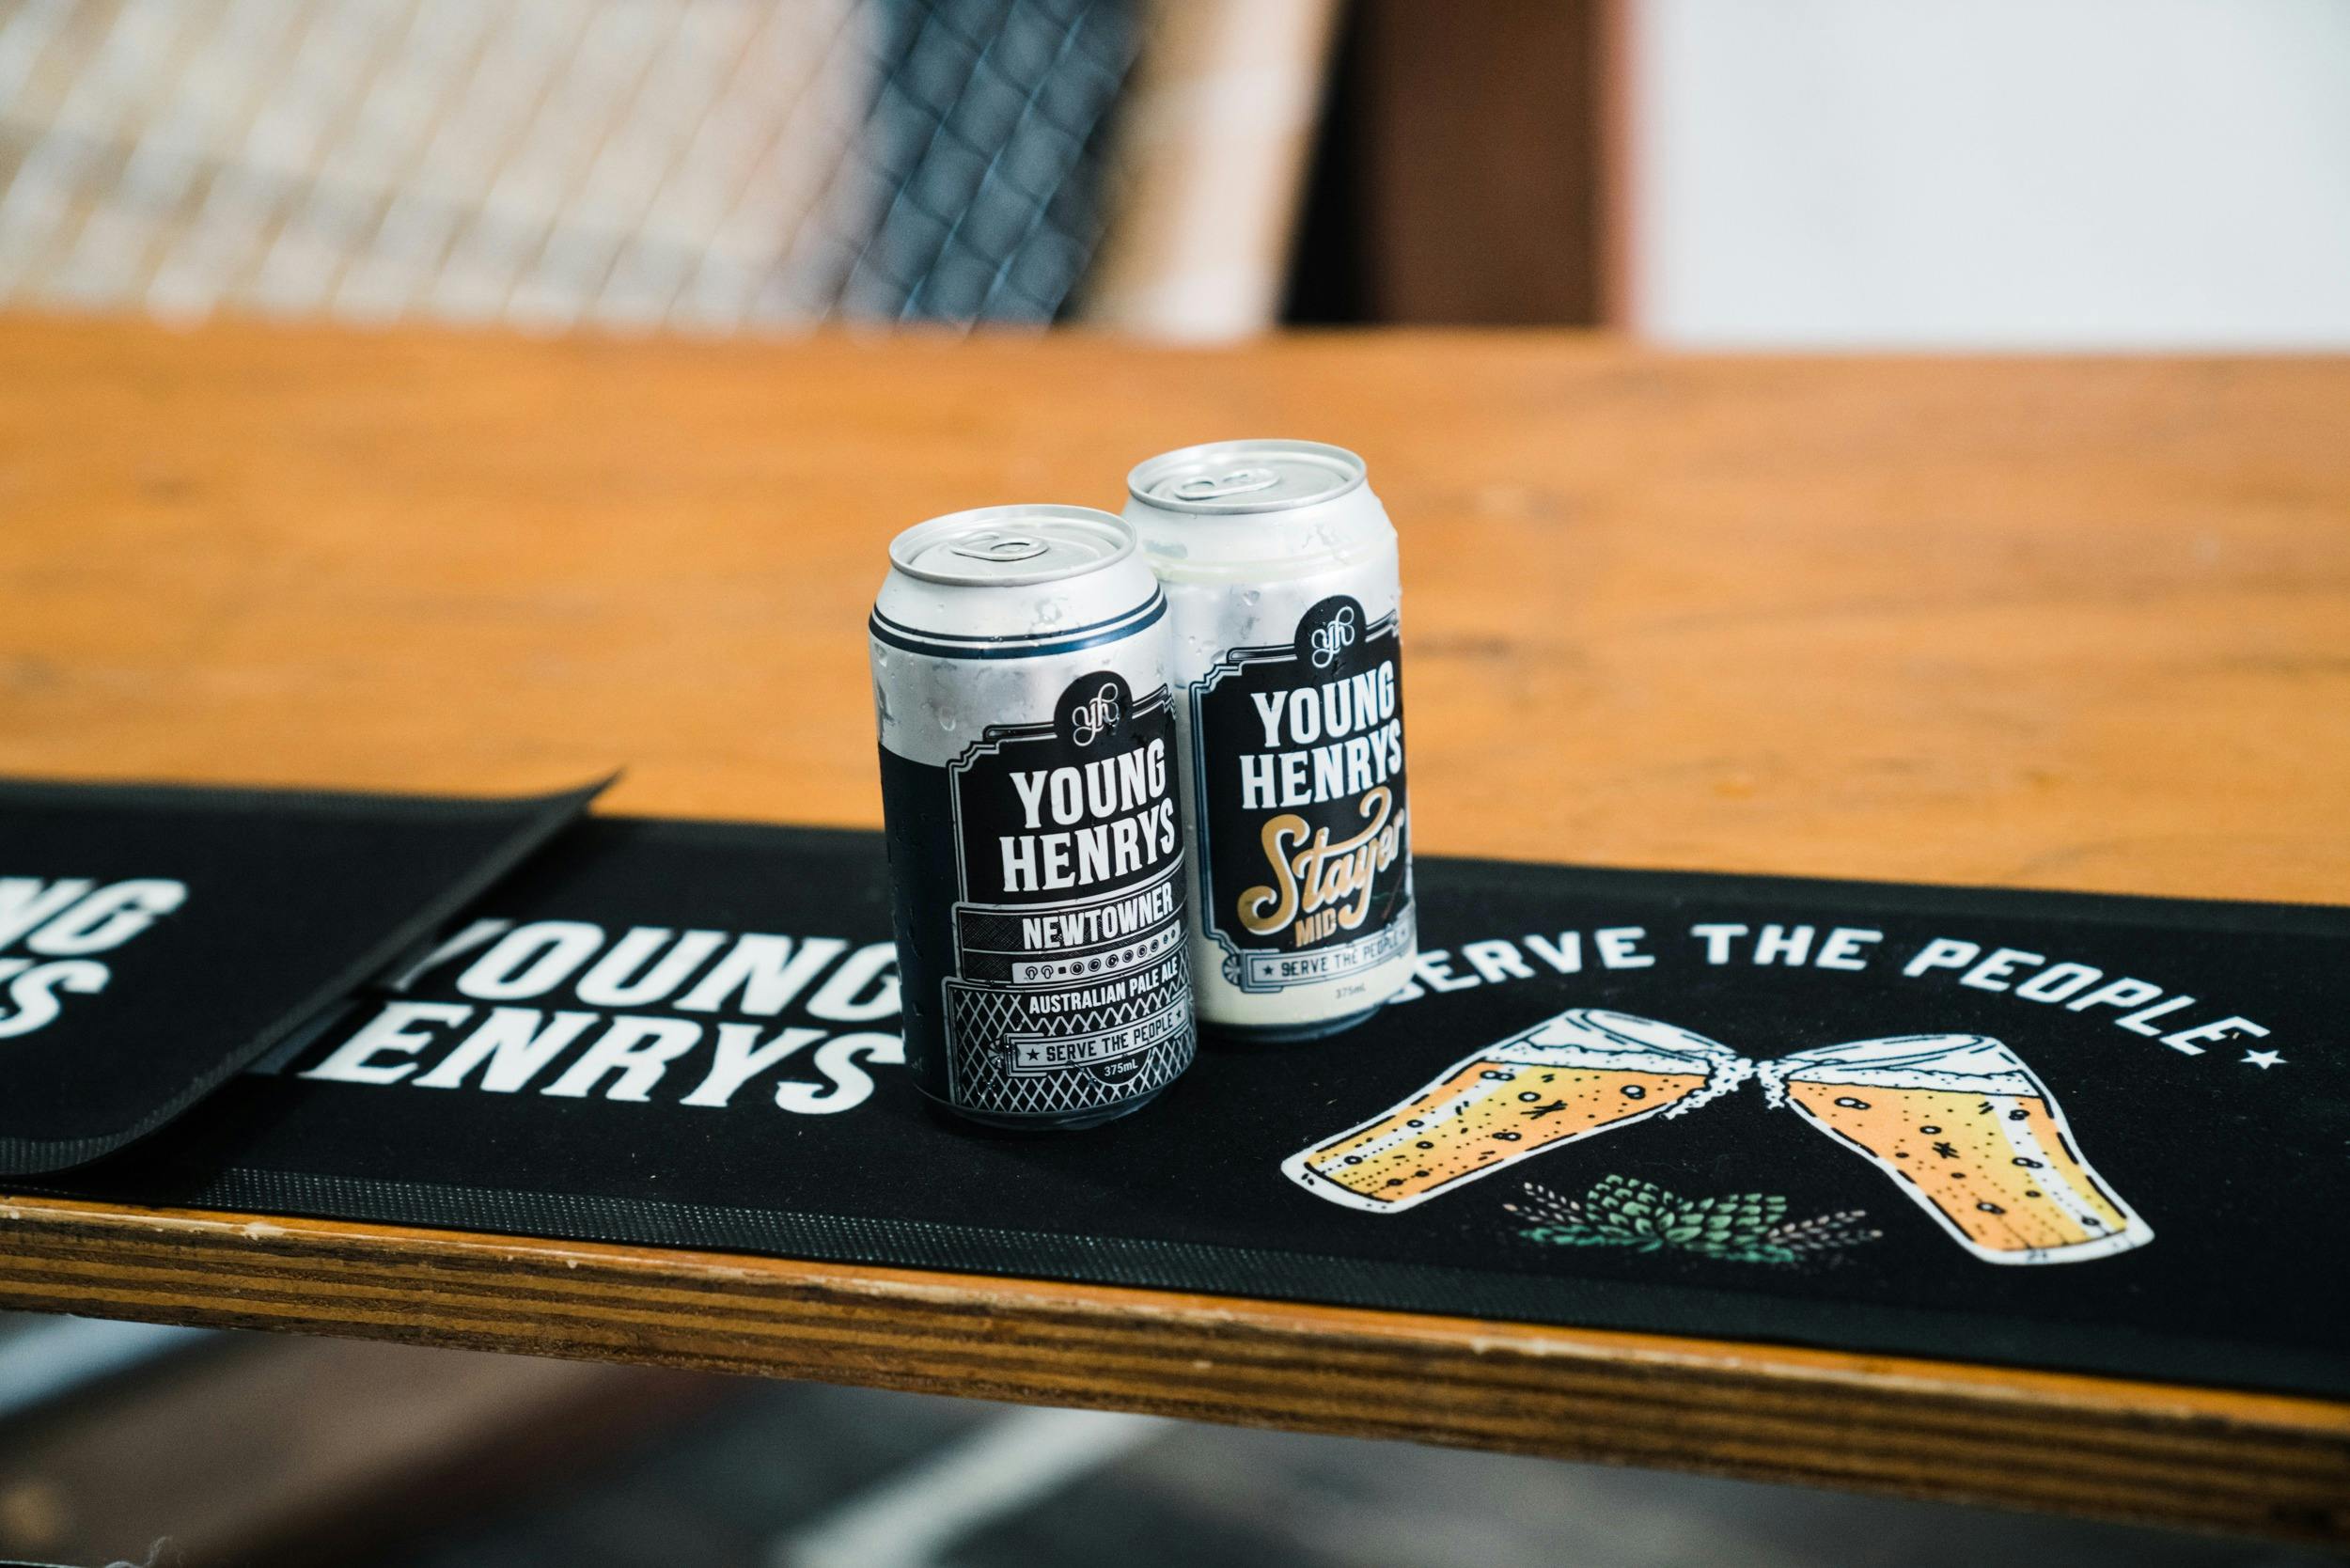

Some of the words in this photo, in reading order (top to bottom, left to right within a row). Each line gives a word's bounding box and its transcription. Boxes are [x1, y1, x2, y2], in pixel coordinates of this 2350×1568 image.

[1250, 660, 1395, 747] YOUNG
[1009, 738, 1167, 829] YOUNG
[1239, 718, 1402, 809] HENRYS
[999, 797, 1175, 892] HENRYS
[1237, 786, 1405, 935] Stayer
[1022, 881, 1174, 950] NEWTOWNER
[1294, 907, 1338, 949] MID
[1029, 981, 1126, 1014] AUSTRALIAN
[1129, 971, 1160, 998] PALE
[1161, 956, 1179, 983] ALE
[1280, 955, 1328, 978] SERVE
[1334, 949, 1358, 970] THE
[1386, 926, 1656, 1004] ERVE
[1691, 923, 1884, 971] THE
[1902, 937, 2271, 1057] PEOPLE
[282, 1000, 905, 1115] ENRYS
[1045, 1040, 1097, 1062] SERVE
[1101, 1032, 1129, 1054] THE
[1134, 1011, 1174, 1045] PEOPLE
[1104, 1058, 1139, 1077] 375mL
